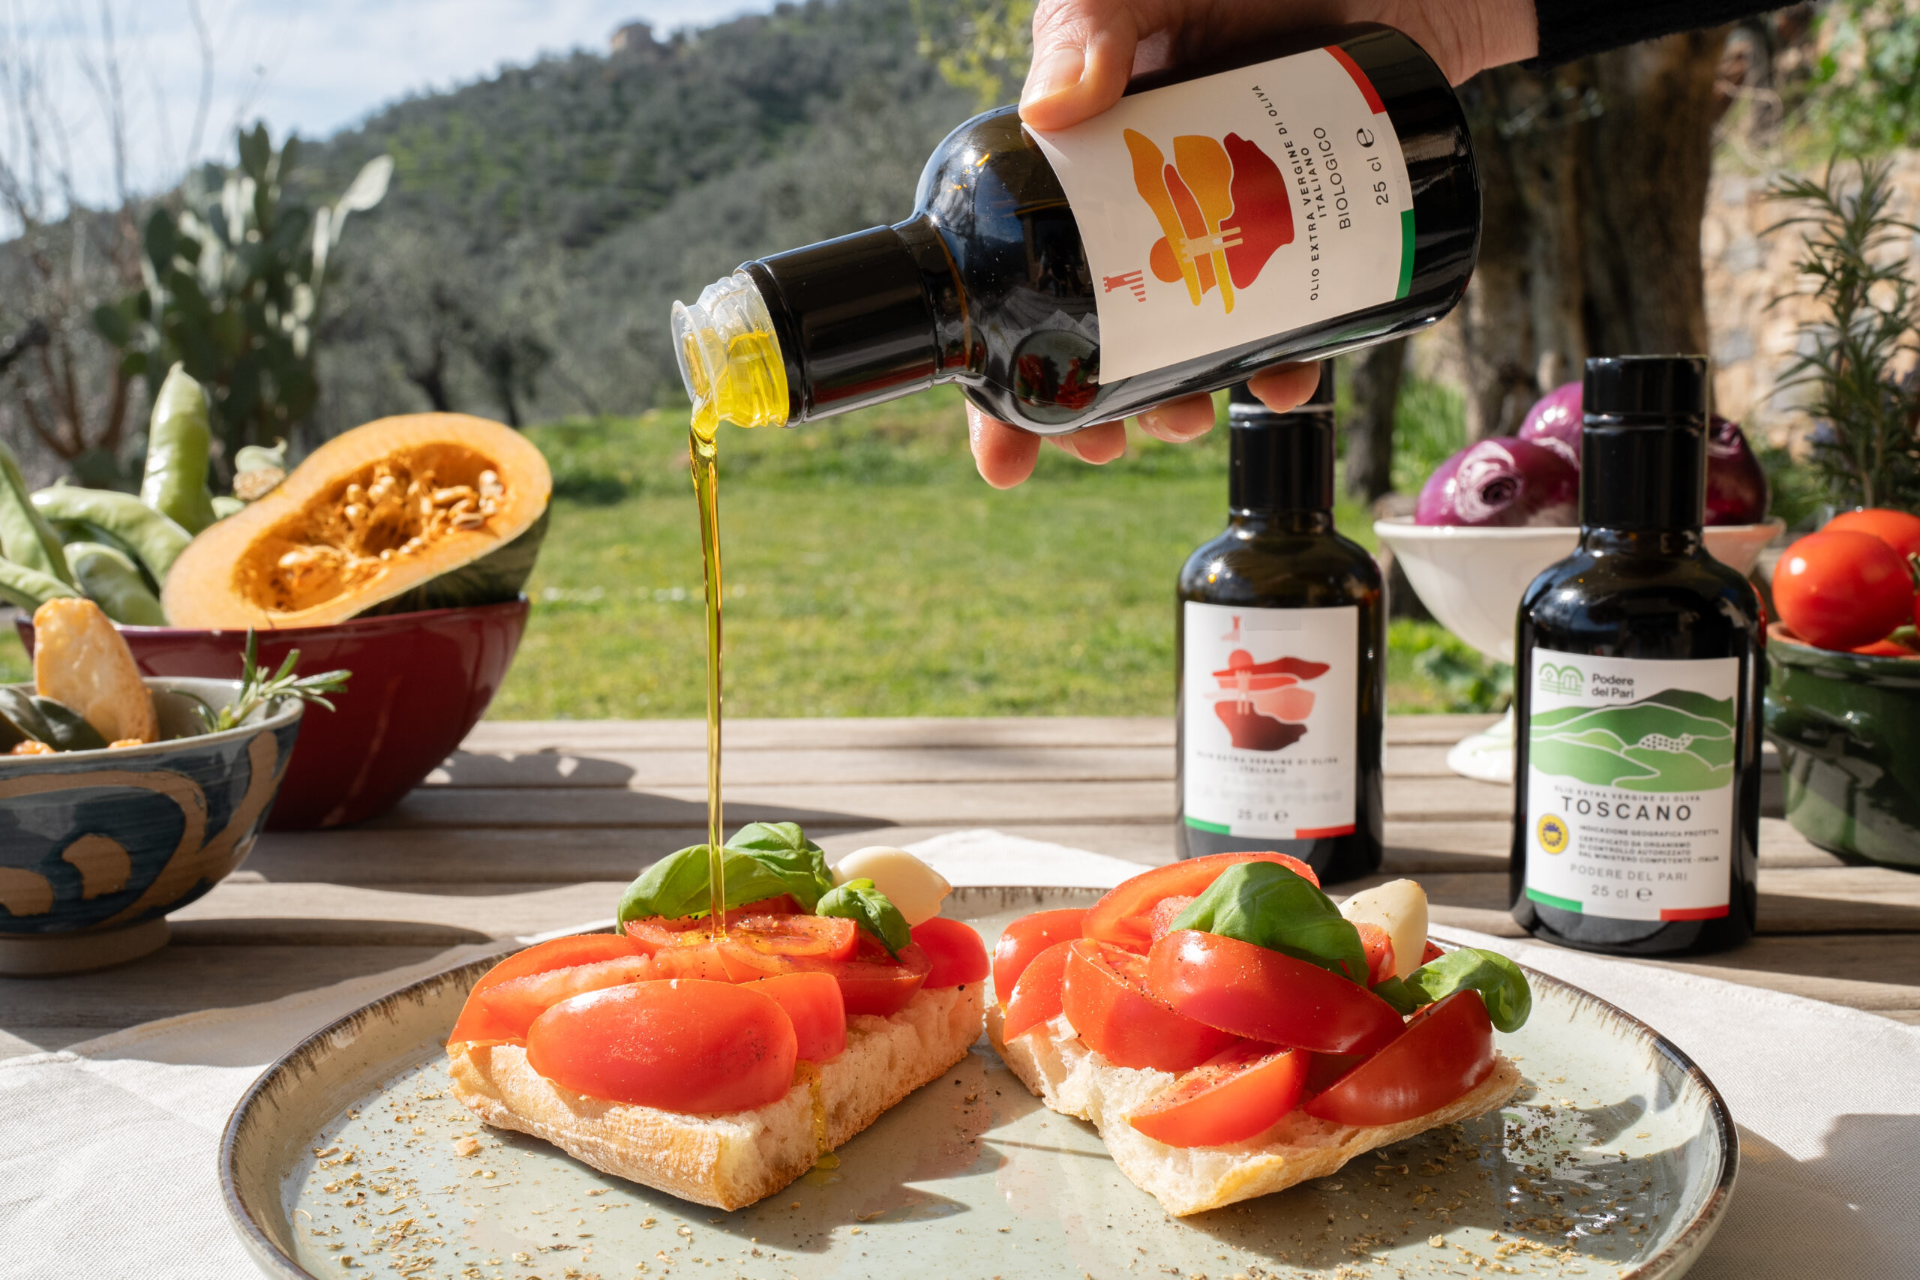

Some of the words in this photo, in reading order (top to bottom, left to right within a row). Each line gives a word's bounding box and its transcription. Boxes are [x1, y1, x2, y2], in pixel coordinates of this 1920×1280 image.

[1251, 85, 1278, 117] OLIVA
[1275, 121, 1288, 135] DI
[1283, 140, 1312, 206] VERGINE
[1366, 156, 1382, 172] cl
[1300, 147, 1327, 218] ITALIANO
[1313, 127, 1351, 230] BIOLOGICO
[1373, 181, 1389, 206] 25
[1306, 212, 1320, 262] EXTRA
[1310, 268, 1320, 301] OLIO
[1592, 673, 1634, 686] Podere
[1592, 687, 1609, 697] del
[1611, 688, 1634, 699] Pari
[1561, 796, 1691, 821] TOSCANO
[1612, 793, 1656, 802] VERGINE
[1570, 863, 1622, 880] PODERE
[1627, 870, 1652, 881] DEL
[1658, 871, 1688, 882] PARI
[1591, 884, 1609, 897] 25
[1616, 888, 1629, 899] cl
